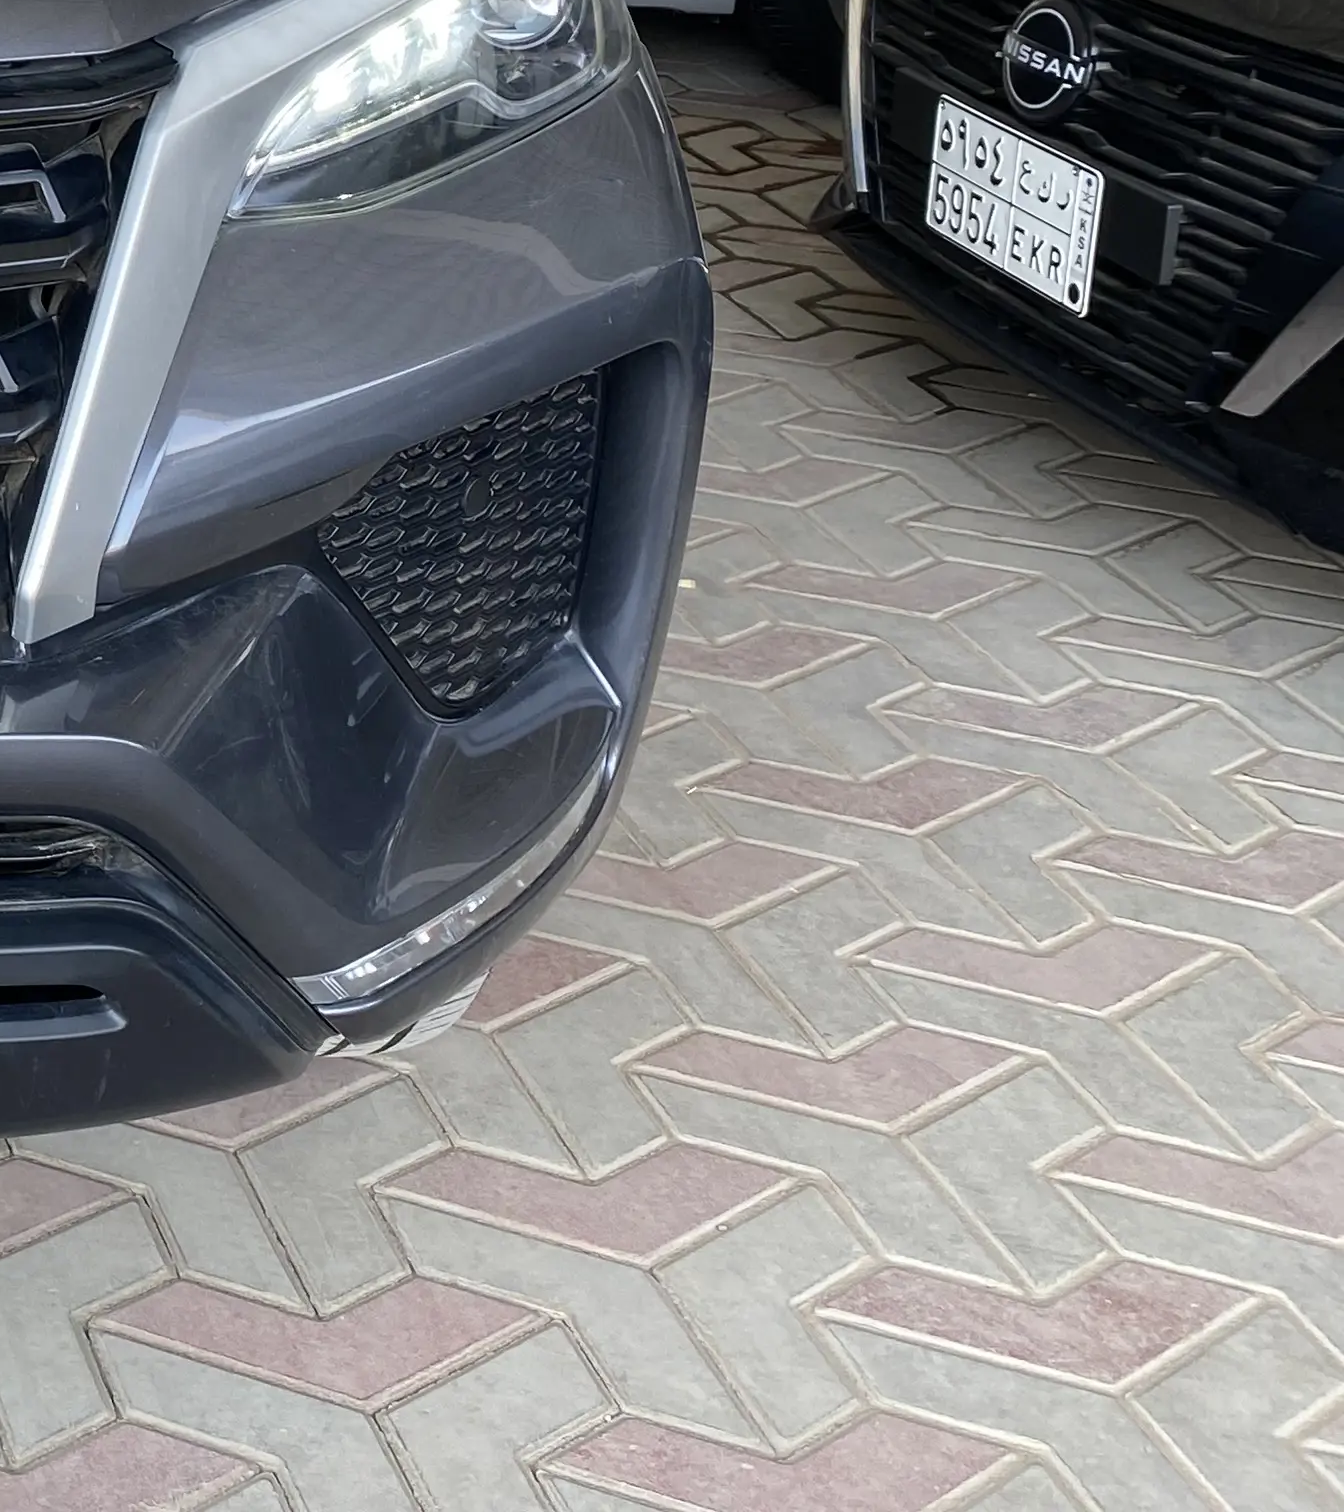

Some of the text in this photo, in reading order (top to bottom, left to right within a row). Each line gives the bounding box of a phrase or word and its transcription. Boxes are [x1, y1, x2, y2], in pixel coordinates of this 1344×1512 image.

[1002, 34, 1086, 84] NISSAN
[940, 118, 1005, 186] ٥٩٥٤
[932, 173, 1064, 284] 5954 EKR
